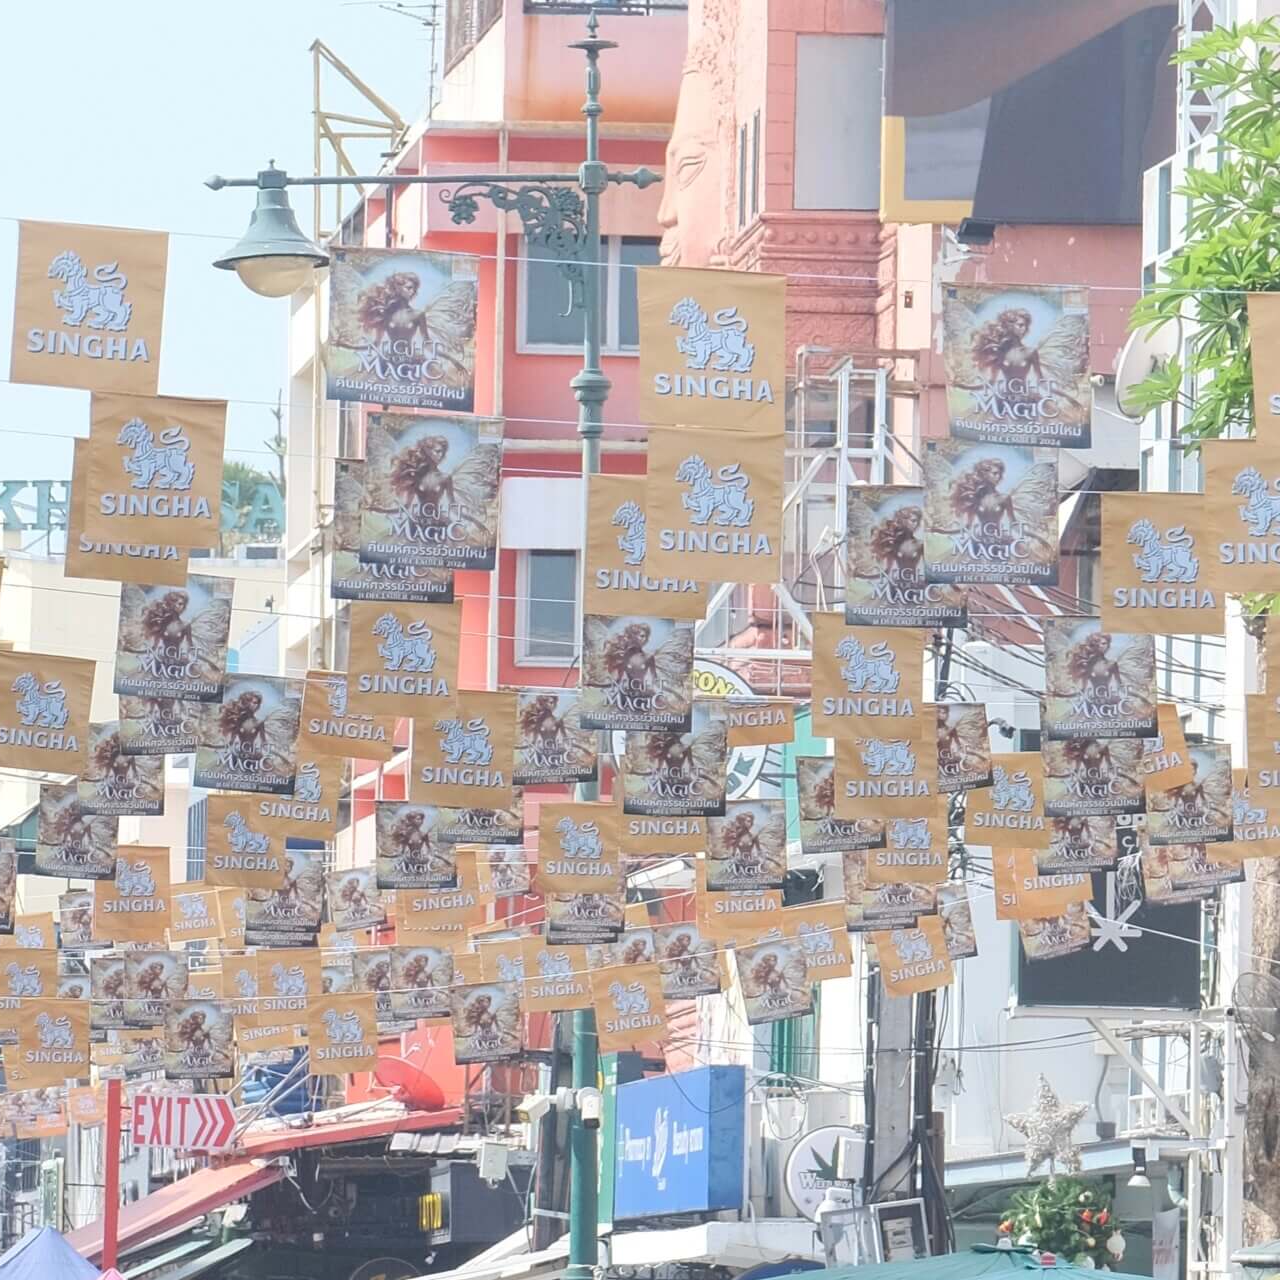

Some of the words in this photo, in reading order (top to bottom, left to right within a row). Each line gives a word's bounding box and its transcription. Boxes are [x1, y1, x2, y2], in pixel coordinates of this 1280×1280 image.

[26, 329, 150, 363] SINGHA
[366, 339, 445, 365] NIGHT
[357, 356, 445, 381] MAGIC
[653, 372, 775, 403] SINGHA
[980, 378, 1057, 397] NIGHT
[973, 395, 1060, 419] MAGIC
[100, 493, 212, 520] SINGHA
[397, 500, 468, 523] NIGHT
[387, 519, 469, 543] MAGIC
[960, 520, 1028, 541] NIGHT
[659, 529, 773, 556] SINGHA
[950, 537, 1030, 560] MAGIC
[870, 582, 942, 605] MAGIC
[1113, 587, 1216, 609] SINGHA
[137, 661, 201, 680] MAGIC
[358, 674, 450, 698] SINGHA
[601, 687, 668, 712] MAGIC
[823, 697, 914, 716] SINGHA
[1068, 699, 1133, 718] MAGIC
[140, 720, 193, 738] MAGIC
[308, 719, 386, 741] SINGHA
[216, 753, 273, 772] MAGIC
[521, 748, 577, 767] MAGIC
[422, 766, 505, 788] SINGHA
[94, 783, 145, 801] MAGIC
[643, 778, 703, 797] MAGIC
[845, 780, 930, 797] SINGHA
[1062, 780, 1121, 796] MAGIC
[260, 801, 332, 823] SINGHA
[973, 812, 1046, 830] SINGHA
[629, 820, 701, 835] SINGHA
[816, 822, 866, 838] MAGIC
[213, 855, 279, 872] SINGHA
[545, 860, 613, 876] SINGHA
[875, 851, 943, 867] SINGHA
[1023, 874, 1085, 891] SINGHA
[103, 900, 166, 914] SINGHA
[412, 895, 475, 911] SINGHA
[714, 899, 777, 913] SINGHA
[889, 960, 946, 983] SINGHA
[530, 984, 584, 998] SINGHA
[606, 1015, 661, 1033] SINGHA
[25, 1049, 85, 1064] SINGHA
[316, 1046, 375, 1060] SINGHA
[134, 1096, 190, 1146] EXIT
